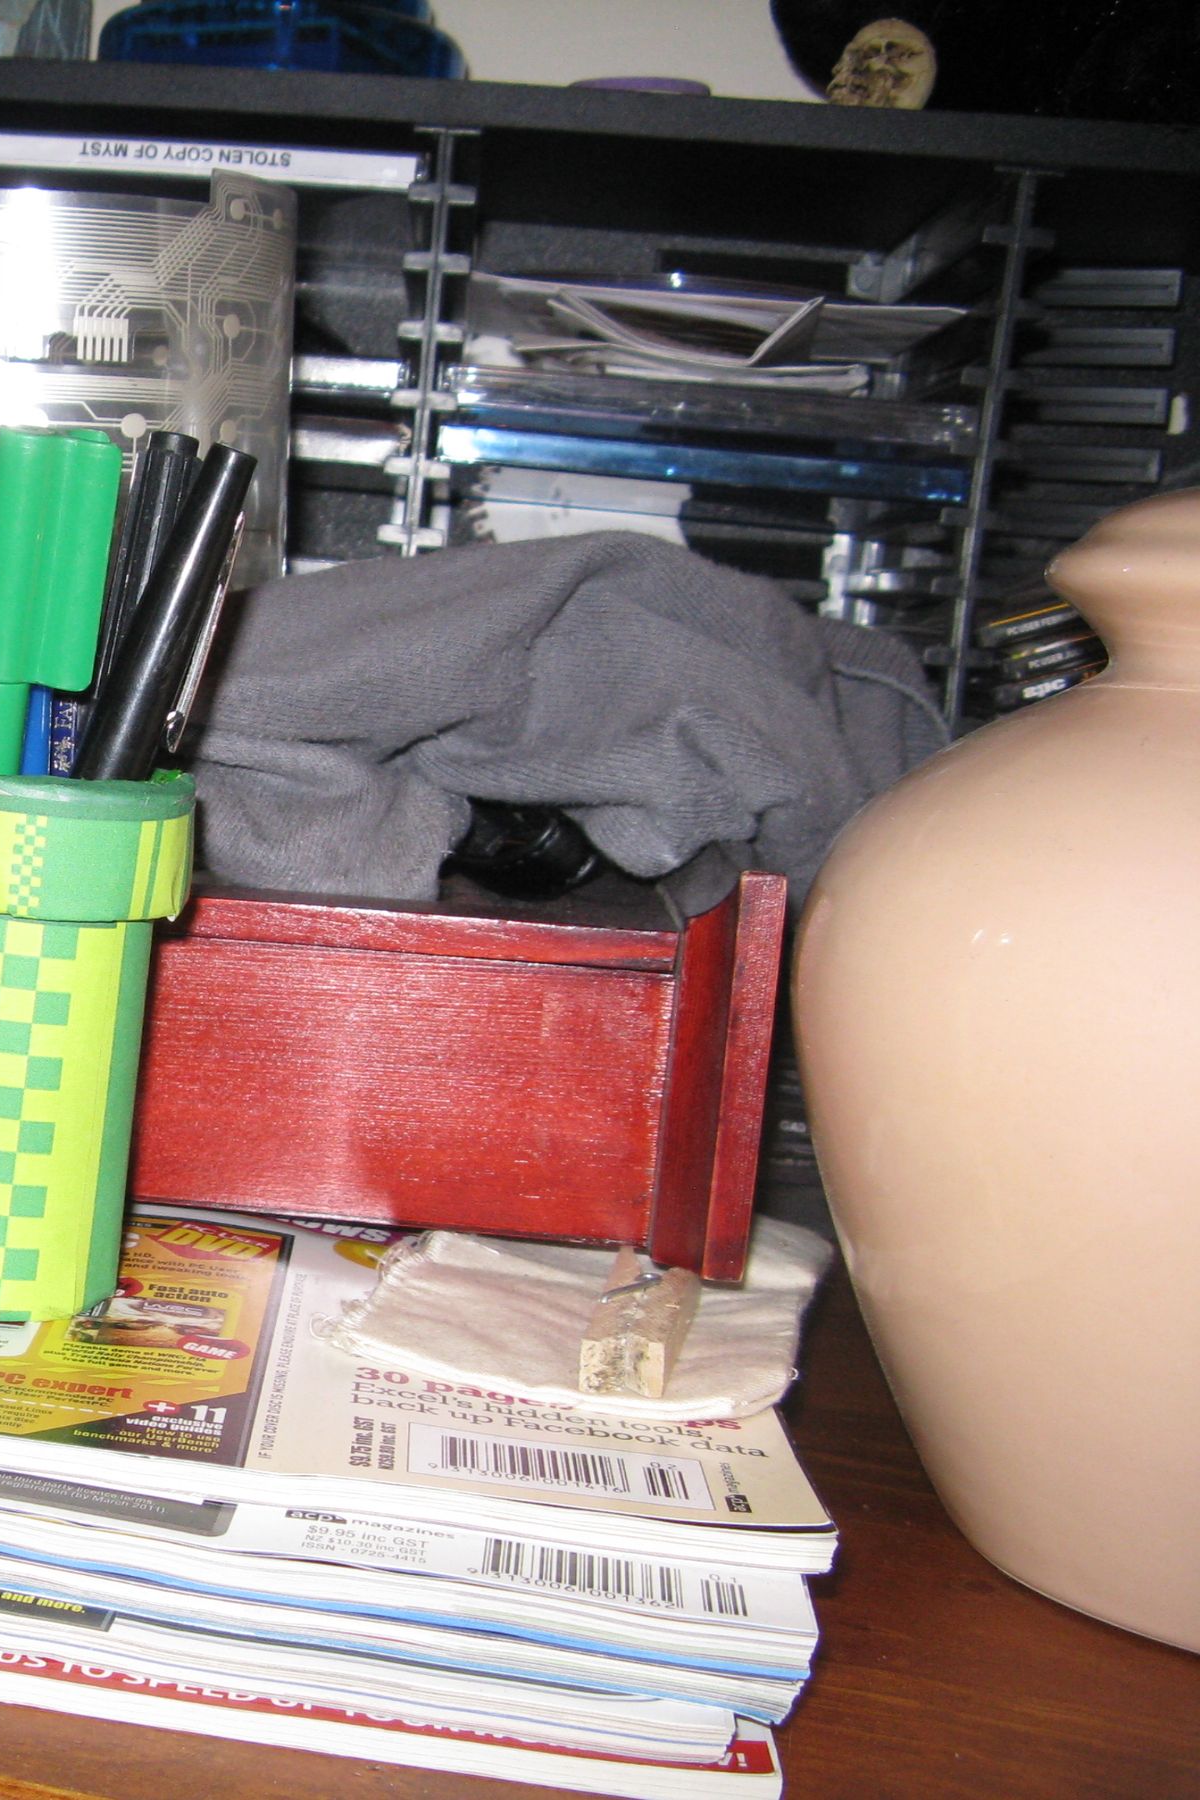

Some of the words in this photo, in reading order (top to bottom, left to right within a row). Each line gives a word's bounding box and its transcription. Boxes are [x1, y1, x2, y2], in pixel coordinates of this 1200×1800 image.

[80, 139, 129, 158] MYST
[133, 142, 159, 160] OF
[163, 144, 213, 163] COPY
[218, 148, 291, 167] STOLEN
[1023, 677, 1067, 699] apc
[159, 1227, 264, 1260] DVD
[148, 1283, 184, 1294] Fast
[188, 1287, 229, 1298] auto
[153, 1289, 211, 1304] action
[182, 1341, 237, 1359] GAME
[355, 1367, 410, 1385] 30
[33, 1373, 133, 1402] expert
[188, 1402, 226, 1424] 11
[266, 1399, 282, 1414] DISC
[351, 1381, 473, 1411] Excel's
[484, 1397, 603, 1427] hidden
[618, 1416, 712, 1441] tools,
[125, 1417, 167, 1430] video
[169, 1422, 222, 1438] guides
[151, 1414, 223, 1431] exclusive
[262, 1413, 280, 1434] COVER
[352, 1415, 374, 1431] GST
[352, 1393, 440, 1417] back
[447, 1409, 493, 1426] up
[504, 1416, 680, 1448] Facebook
[691, 1438, 769, 1459] data
[379, 1421, 396, 1434] GST
[73, 1427, 157, 1448] benchmarks
[176, 1443, 216, 1454] more.
[118, 1430, 140, 1438] our
[145, 1431, 219, 1450] UserBench
[145, 1426, 175, 1436] How
[196, 1433, 220, 1442] use
[258, 1433, 276, 1452] YOUR
[351, 1428, 373, 1446] inc.
[257, 1451, 272, 1459] IF
[349, 1443, 372, 1468] $9.75
[450, 1465, 532, 1483] 313006
[649, 1461, 678, 1471] 02
[307, 1524, 356, 1540] $9.95
[361, 1531, 388, 1545] inc
[392, 1536, 428, 1550] GST
[351, 1518, 455, 1541] magazines
[301, 1540, 336, 1553] ISSN
[304, 1533, 325, 1543] NZ
[327, 1535, 375, 1550] $10.30
[376, 1542, 397, 1554] inc
[398, 1546, 427, 1558] GST
[708, 1572, 738, 1583] 01
[487, 1570, 578, 1593] 313006
[589, 1588, 676, 1609] 001362
[0, 1589, 36, 1604] and
[36, 1597, 87, 1614] more.
